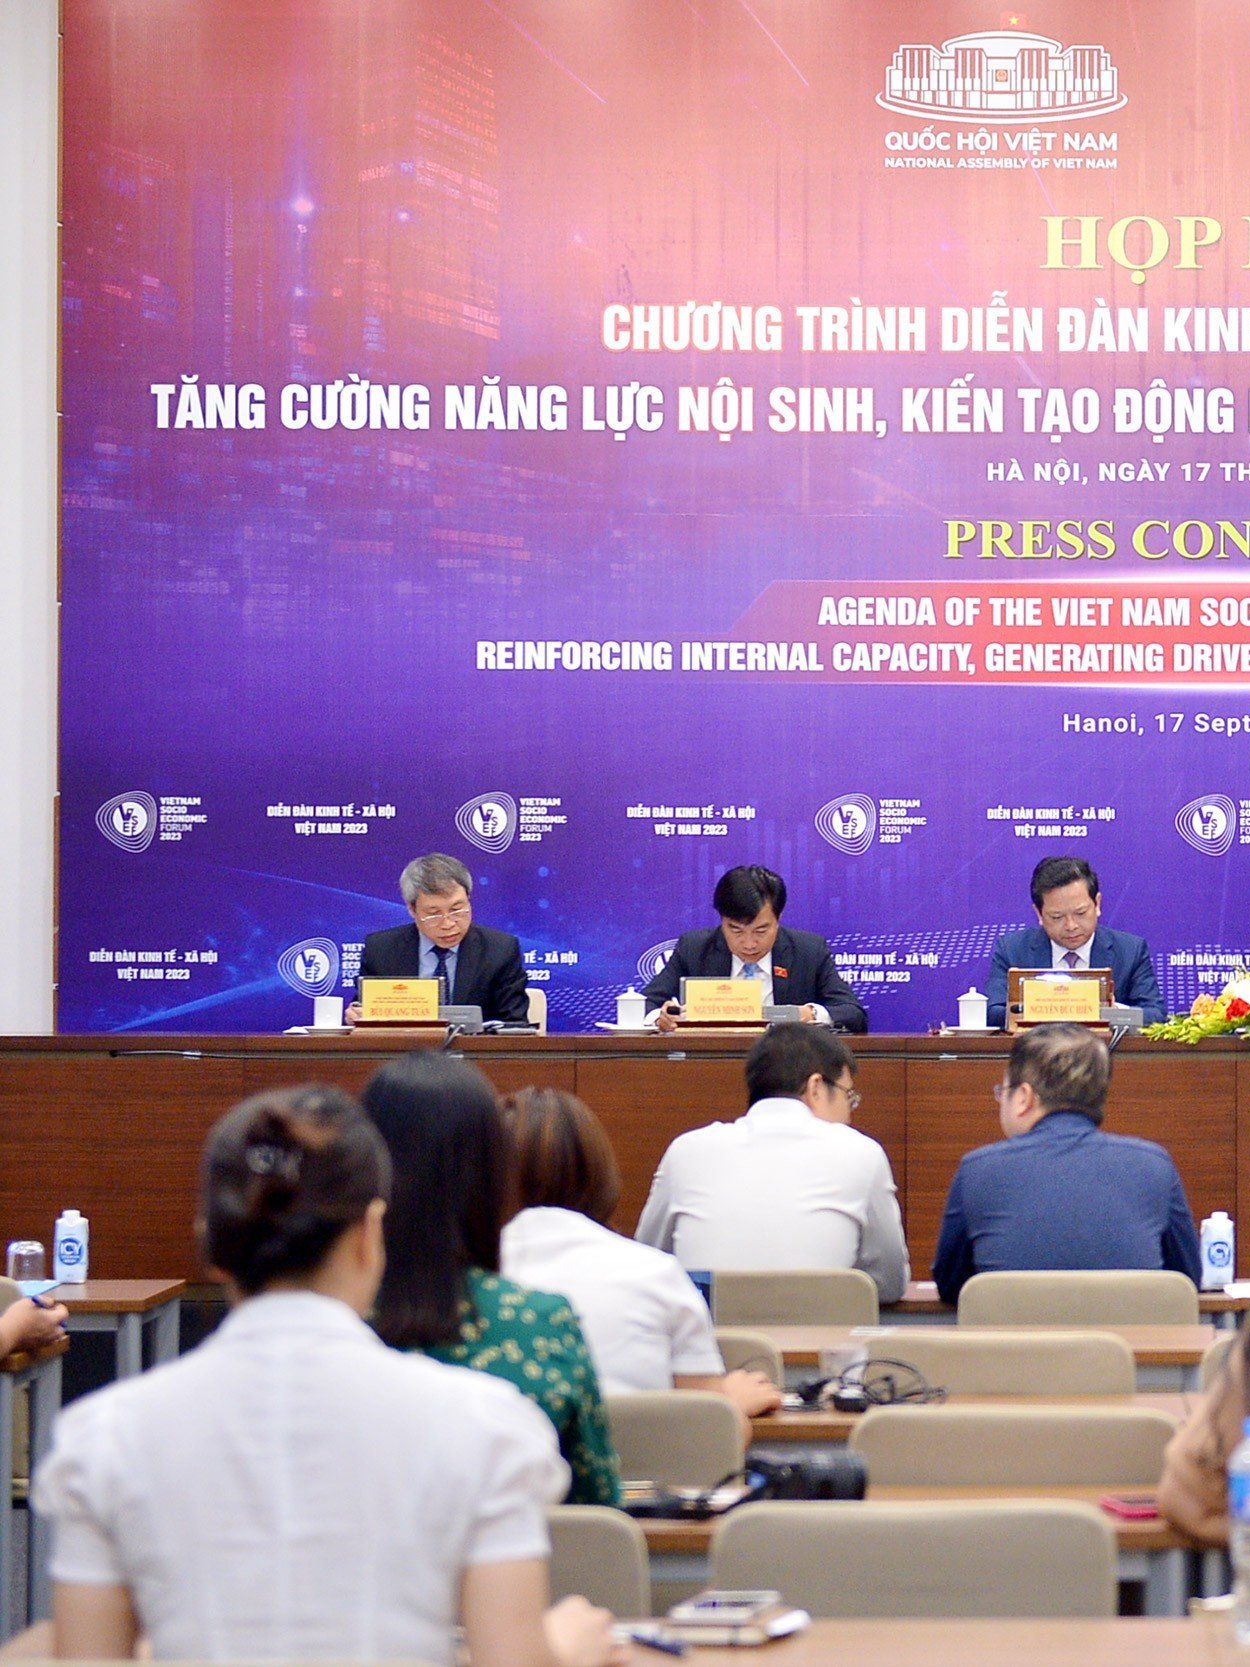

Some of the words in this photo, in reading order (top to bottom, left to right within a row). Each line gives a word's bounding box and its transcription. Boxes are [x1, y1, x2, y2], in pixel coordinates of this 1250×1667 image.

[884, 124, 951, 151] QUỐC
[957, 127, 998, 156] HỘI
[1003, 127, 1058, 156] VIỆT
[1063, 132, 1118, 151] NAM
[884, 157, 955, 168] NATIONAL
[957, 157, 1028, 169] ASSEMBLY
[1030, 157, 1050, 169] OF
[1052, 158, 1084, 169] VIET
[1085, 158, 1117, 169] NAM
[1040, 214, 1224, 286] HỌP
[602, 299, 784, 352] CHƯƠNG
[795, 295, 927, 353] TRÌNH
[940, 289, 1044, 353] DIỄN
[1055, 296, 1150, 353] ĐÀN
[149, 373, 267, 430] TĂNG
[280, 372, 431, 431] CƯỜNG
[443, 374, 569, 432] NĂNG
[581, 380, 665, 442] LỰC
[677, 375, 755, 443] NỘI
[767, 385, 888, 439] SINH,
[901, 372, 1005, 434] KIẾN
[1016, 386, 1101, 444] TẠO
[1111, 377, 1235, 444] ĐỘNG
[987, 458, 1025, 481] HÀ
[1033, 458, 1088, 486] NỘI,
[1098, 458, 1171, 482] NGÀY
[1180, 462, 1211, 482] 17
[944, 519, 1117, 560] PRESS
[817, 595, 938, 627] AGENDA
[944, 596, 982, 627] OF
[987, 596, 1043, 627] THE
[1050, 596, 1114, 627] VIET
[1121, 596, 1191, 627] NAM
[476, 640, 673, 672] REINFORCING
[680, 641, 825, 672] INTERNAL
[831, 641, 977, 676] CAPACITY,
[984, 642, 1165, 673] GENERATING
[1063, 713, 1144, 736] Hanoi,
[1154, 713, 1185, 733] 17
[159, 805, 188, 814] SOCIO
[160, 797, 201, 805] VIETNAM
[159, 823, 193, 832] FORUM
[160, 815, 207, 823] ECONOMIC
[1014, 823, 1037, 839] VIỆT
[1037, 825, 1062, 837] NAM
[1062, 825, 1088, 837] 2023
[159, 832, 182, 841] 2023
